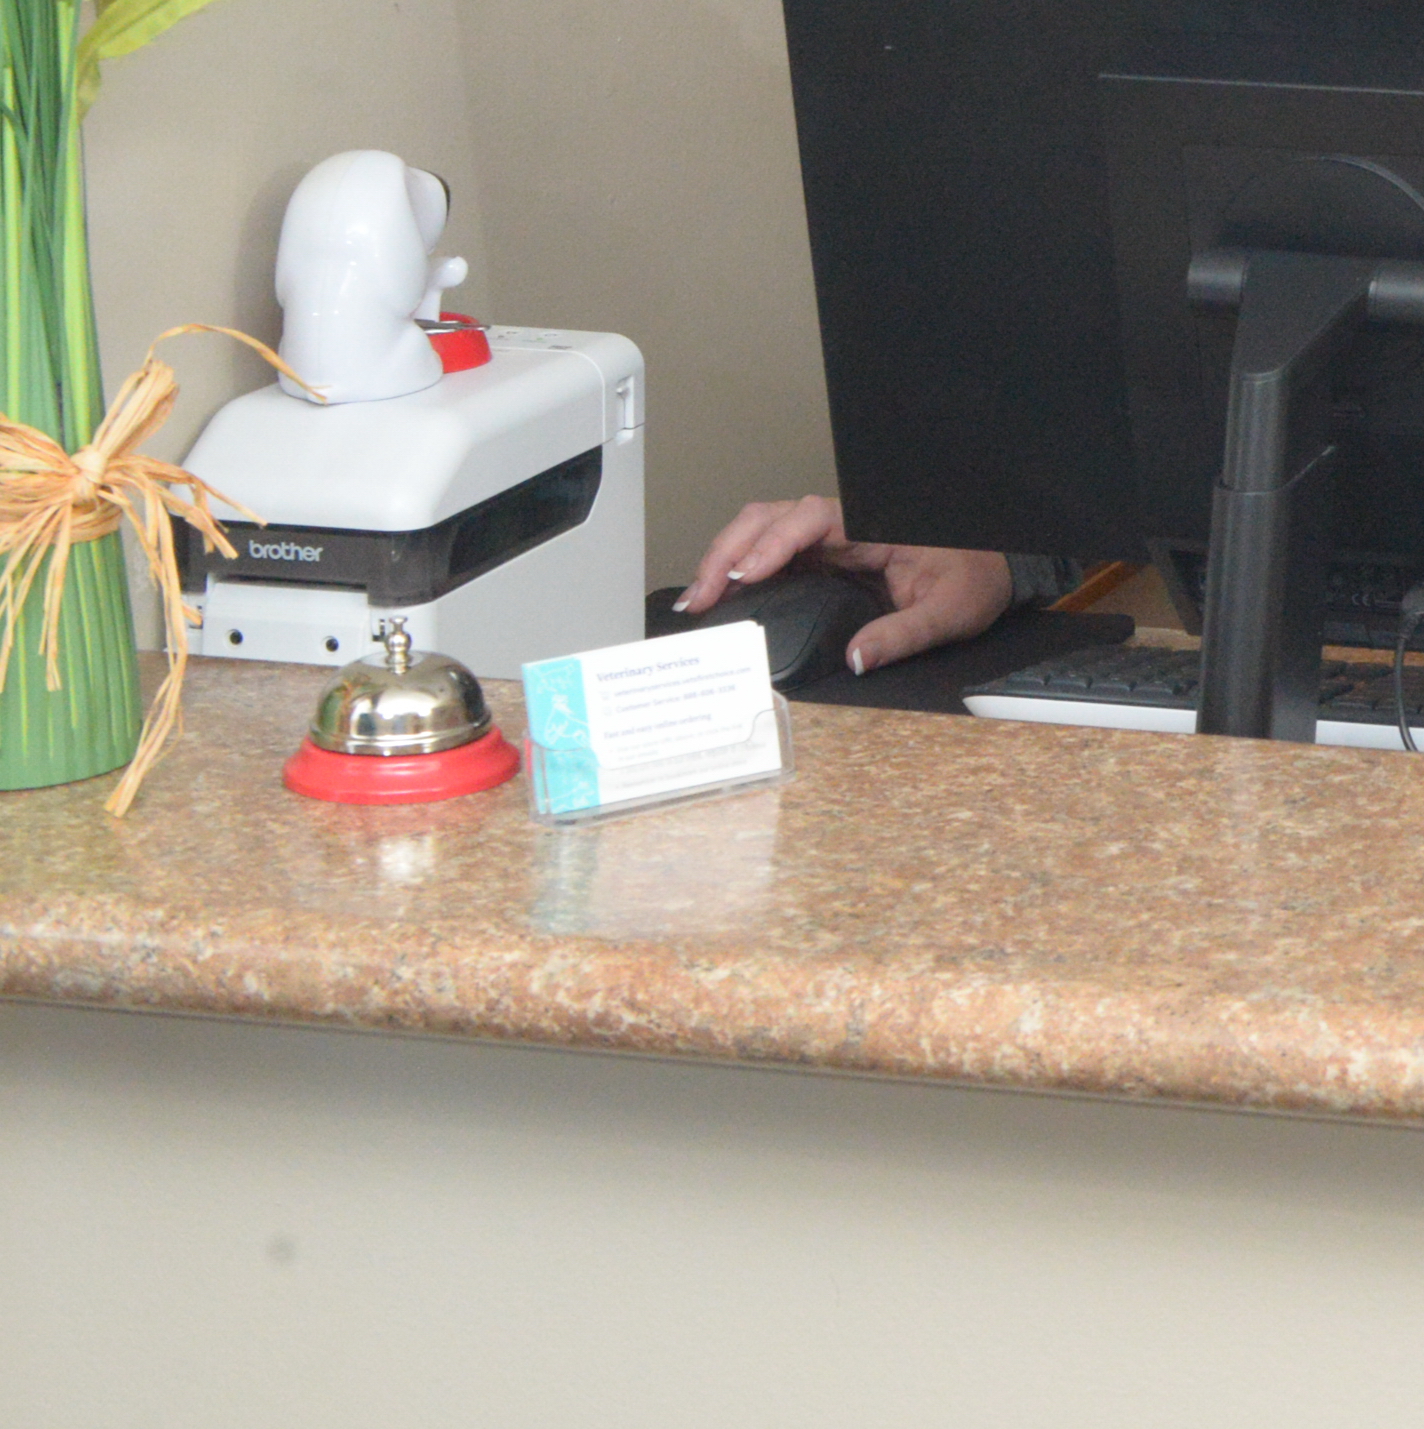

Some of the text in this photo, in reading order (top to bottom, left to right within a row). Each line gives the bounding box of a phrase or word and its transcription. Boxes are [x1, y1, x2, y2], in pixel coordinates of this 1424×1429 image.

[248, 539, 323, 562] brother
[596, 655, 701, 684] Veterinary Services
